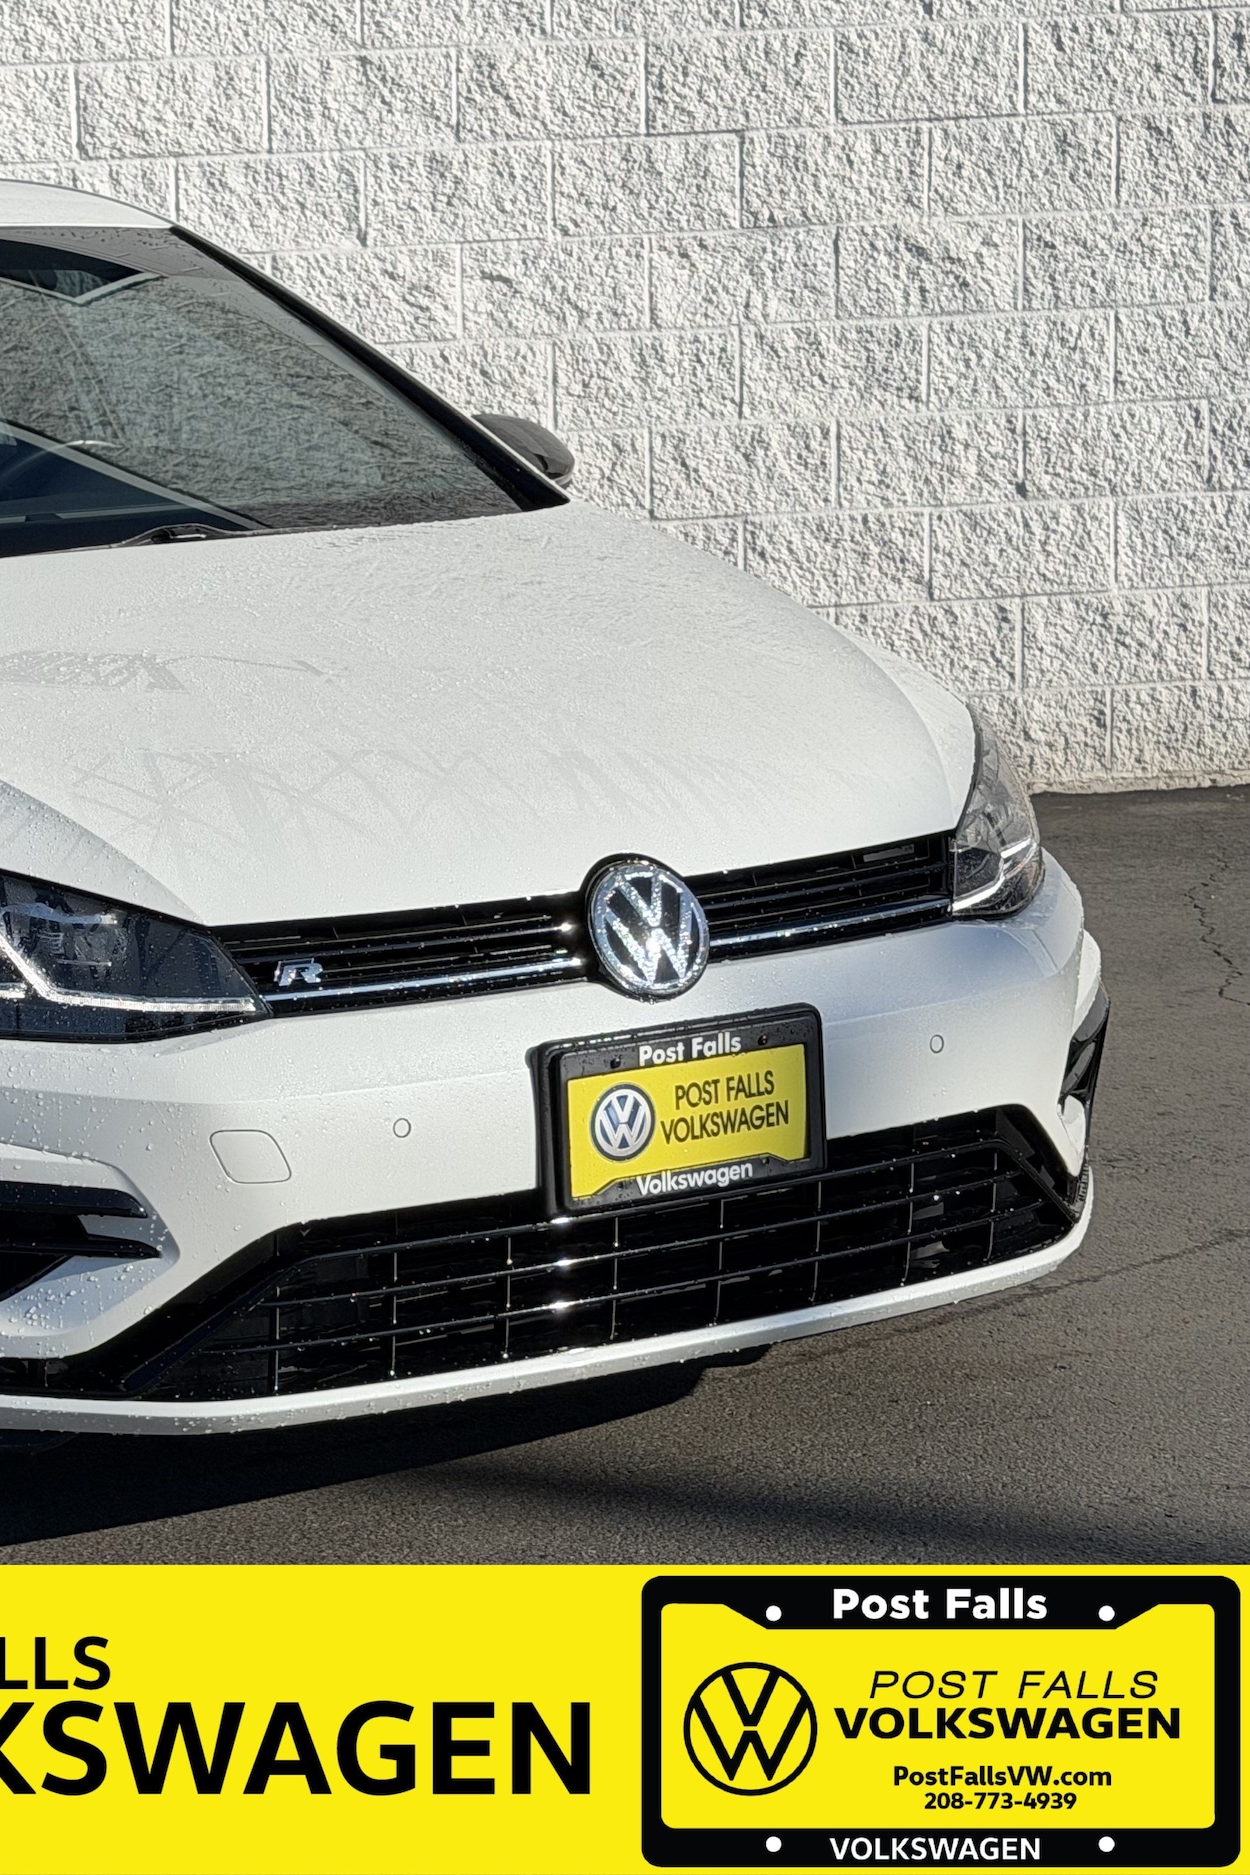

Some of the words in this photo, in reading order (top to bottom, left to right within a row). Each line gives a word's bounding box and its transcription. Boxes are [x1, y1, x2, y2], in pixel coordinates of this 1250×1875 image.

[591, 864, 709, 993] VW
[276, 957, 323, 986] R
[639, 1043, 685, 1067] Post
[691, 1031, 741, 1058] Falls
[675, 1079, 721, 1110] POST
[725, 1070, 775, 1102] FALLS
[591, 1084, 655, 1162] VW
[660, 1100, 789, 1144] VOLKSWAGEN
[636, 1162, 753, 1196] Volkswagen
